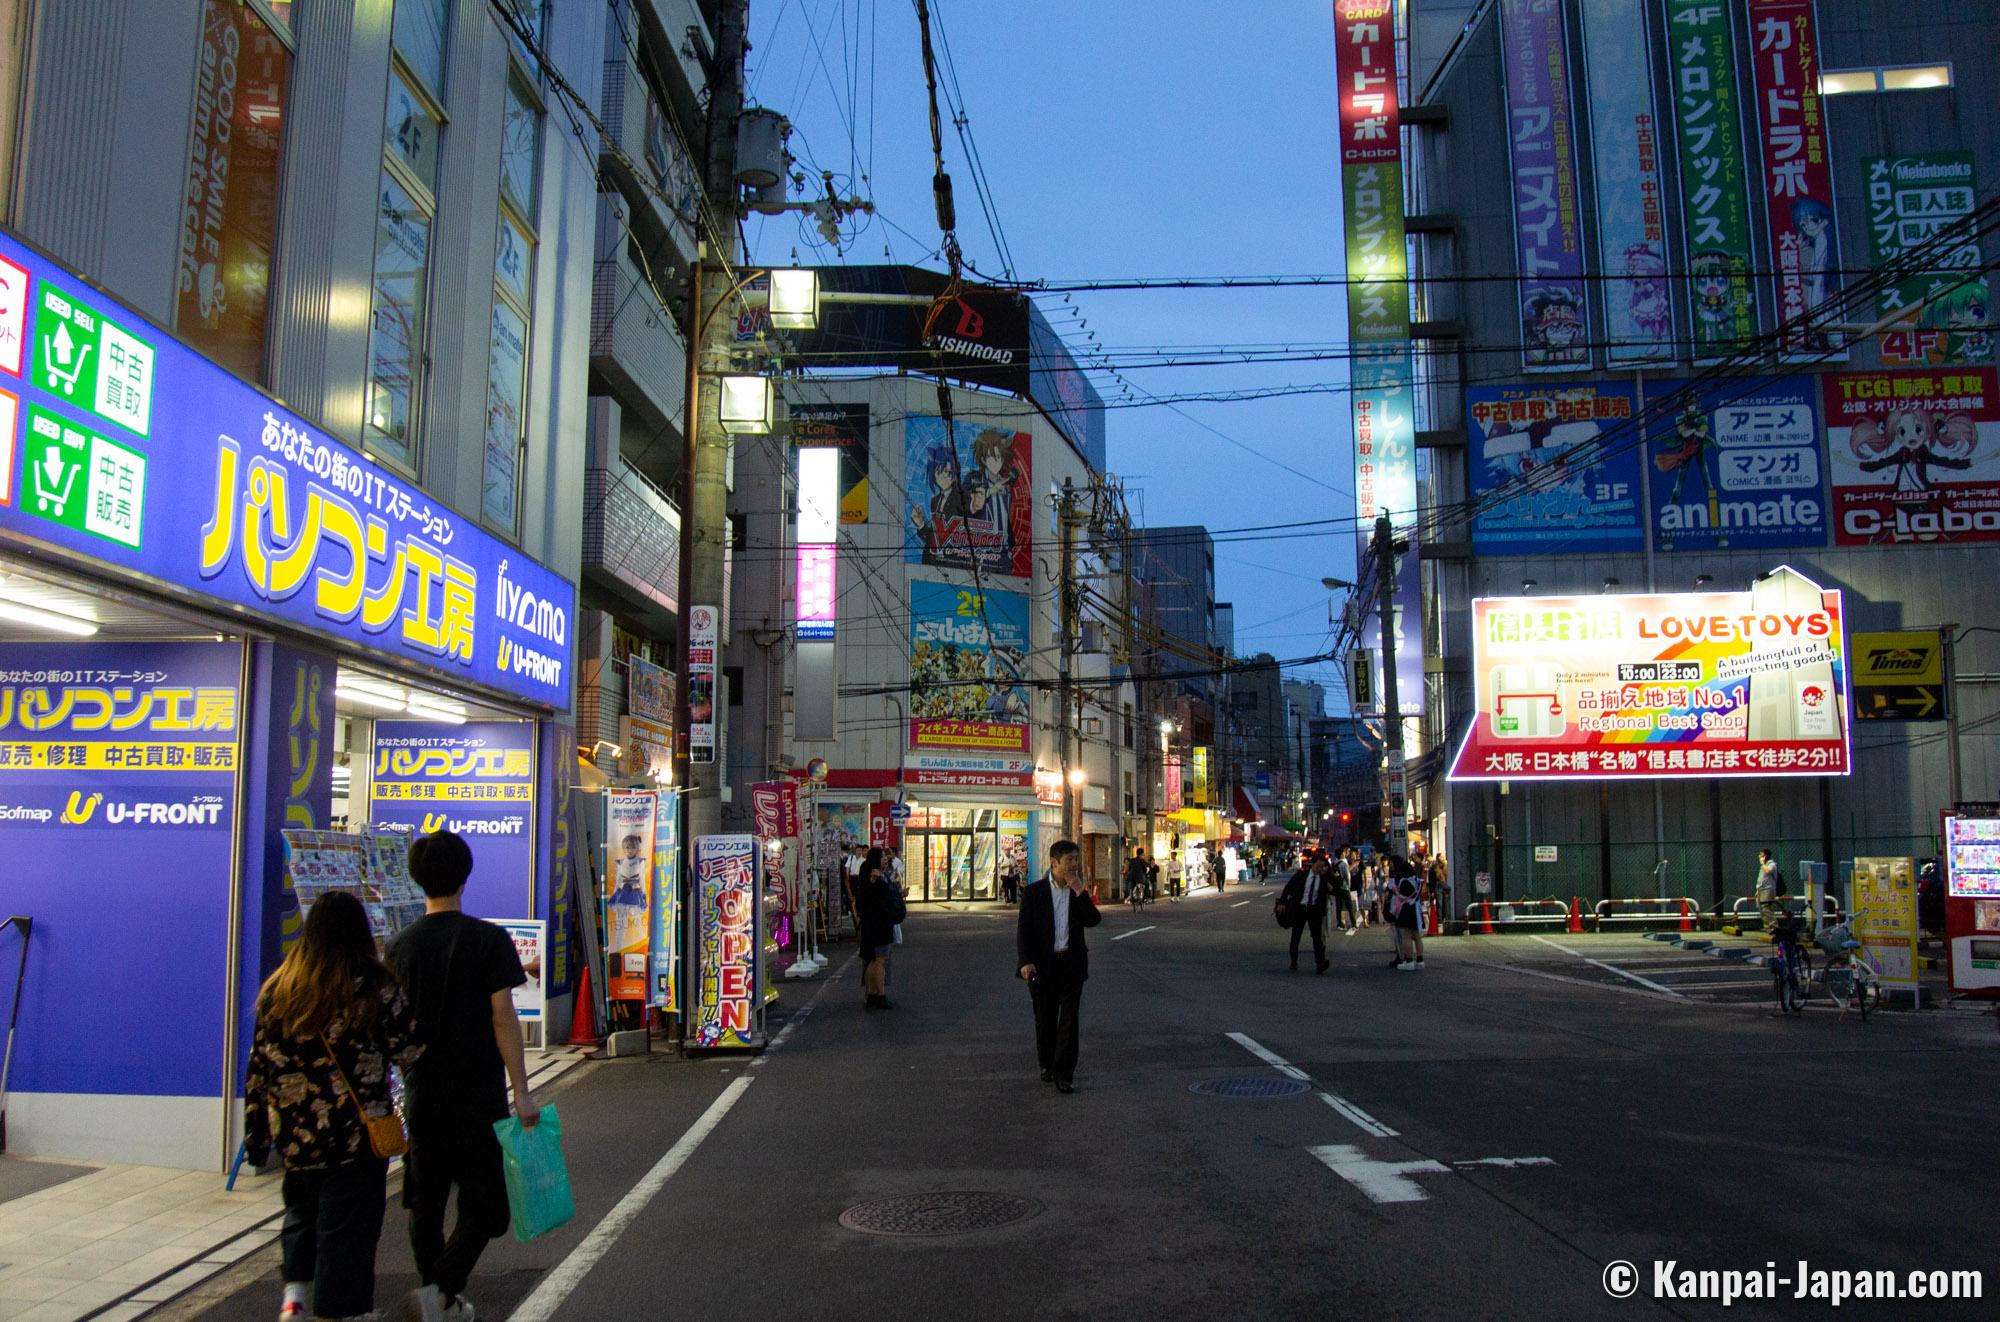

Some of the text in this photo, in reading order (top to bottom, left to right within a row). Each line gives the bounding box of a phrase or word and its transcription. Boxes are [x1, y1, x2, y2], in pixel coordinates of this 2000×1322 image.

[1345, 9, 1382, 20] CARD
[1673, 7, 1721, 26] 4F
[1346, 22, 1388, 140] カードラボ
[1758, 16, 1809, 198] カードラボ
[203, 25, 240, 259] GOOD SMILE
[1680, 36, 1726, 245] メロンブックス
[1345, 149, 1397, 160] C-labo
[1897, 162, 1972, 179] Melonbooks
[1902, 191, 1967, 212] 同人誌
[1354, 166, 1389, 318] メロンブックス
[74, 307, 96, 333] SELL
[1883, 331, 1935, 360] 4F
[109, 341, 144, 384] 中古
[105, 374, 140, 417] 買取
[1472, 398, 1630, 422] 中古買取・中古販売
[1730, 410, 1796, 430] アニメ
[1720, 434, 1748, 443] ANIME
[1357, 400, 1375, 519] 中古買取・中古販売
[1733, 453, 1800, 473] マンガ
[99, 455, 133, 495] 中古
[262, 411, 454, 545] あなたの街のITステーション
[1594, 483, 1629, 500] 3F
[96, 490, 131, 530] 販売
[1660, 494, 1820, 530] animate
[1843, 505, 2000, 535] C-labo
[202, 440, 477, 663] パソコン工房
[496, 560, 565, 646] iiyama
[957, 591, 987, 616] 2F
[514, 643, 562, 688] U-FRONT
[1718, 643, 1818, 669] A buildingfull of
[1720, 651, 1836, 678] interesting goods!
[1868, 649, 1926, 671] Times
[0, 670, 168, 683] あなたの街のITステーション
[1621, 668, 1655, 679] 10:00
[1662, 667, 1698, 679] 23:00
[1578, 687, 1744, 709] 品揃え地域 No.1
[918, 723, 1022, 737] フィギュア・ホビー商品充実
[1580, 714, 1744, 732] Regional Best Shop
[377, 738, 486, 747] あなたの街のITステーション
[105, 745, 233, 767] 中古買取・販売
[376, 750, 530, 776] パソコン工房
[1009, 761, 1020, 770] 2F
[376, 785, 529, 798] 販売・修理 中古買取・販売
[107, 803, 223, 824] U-FRONT
[450, 821, 523, 833] U-FRONT
[554, 735, 571, 983] パソコン工房
[719, 888, 752, 1032] OPEN
